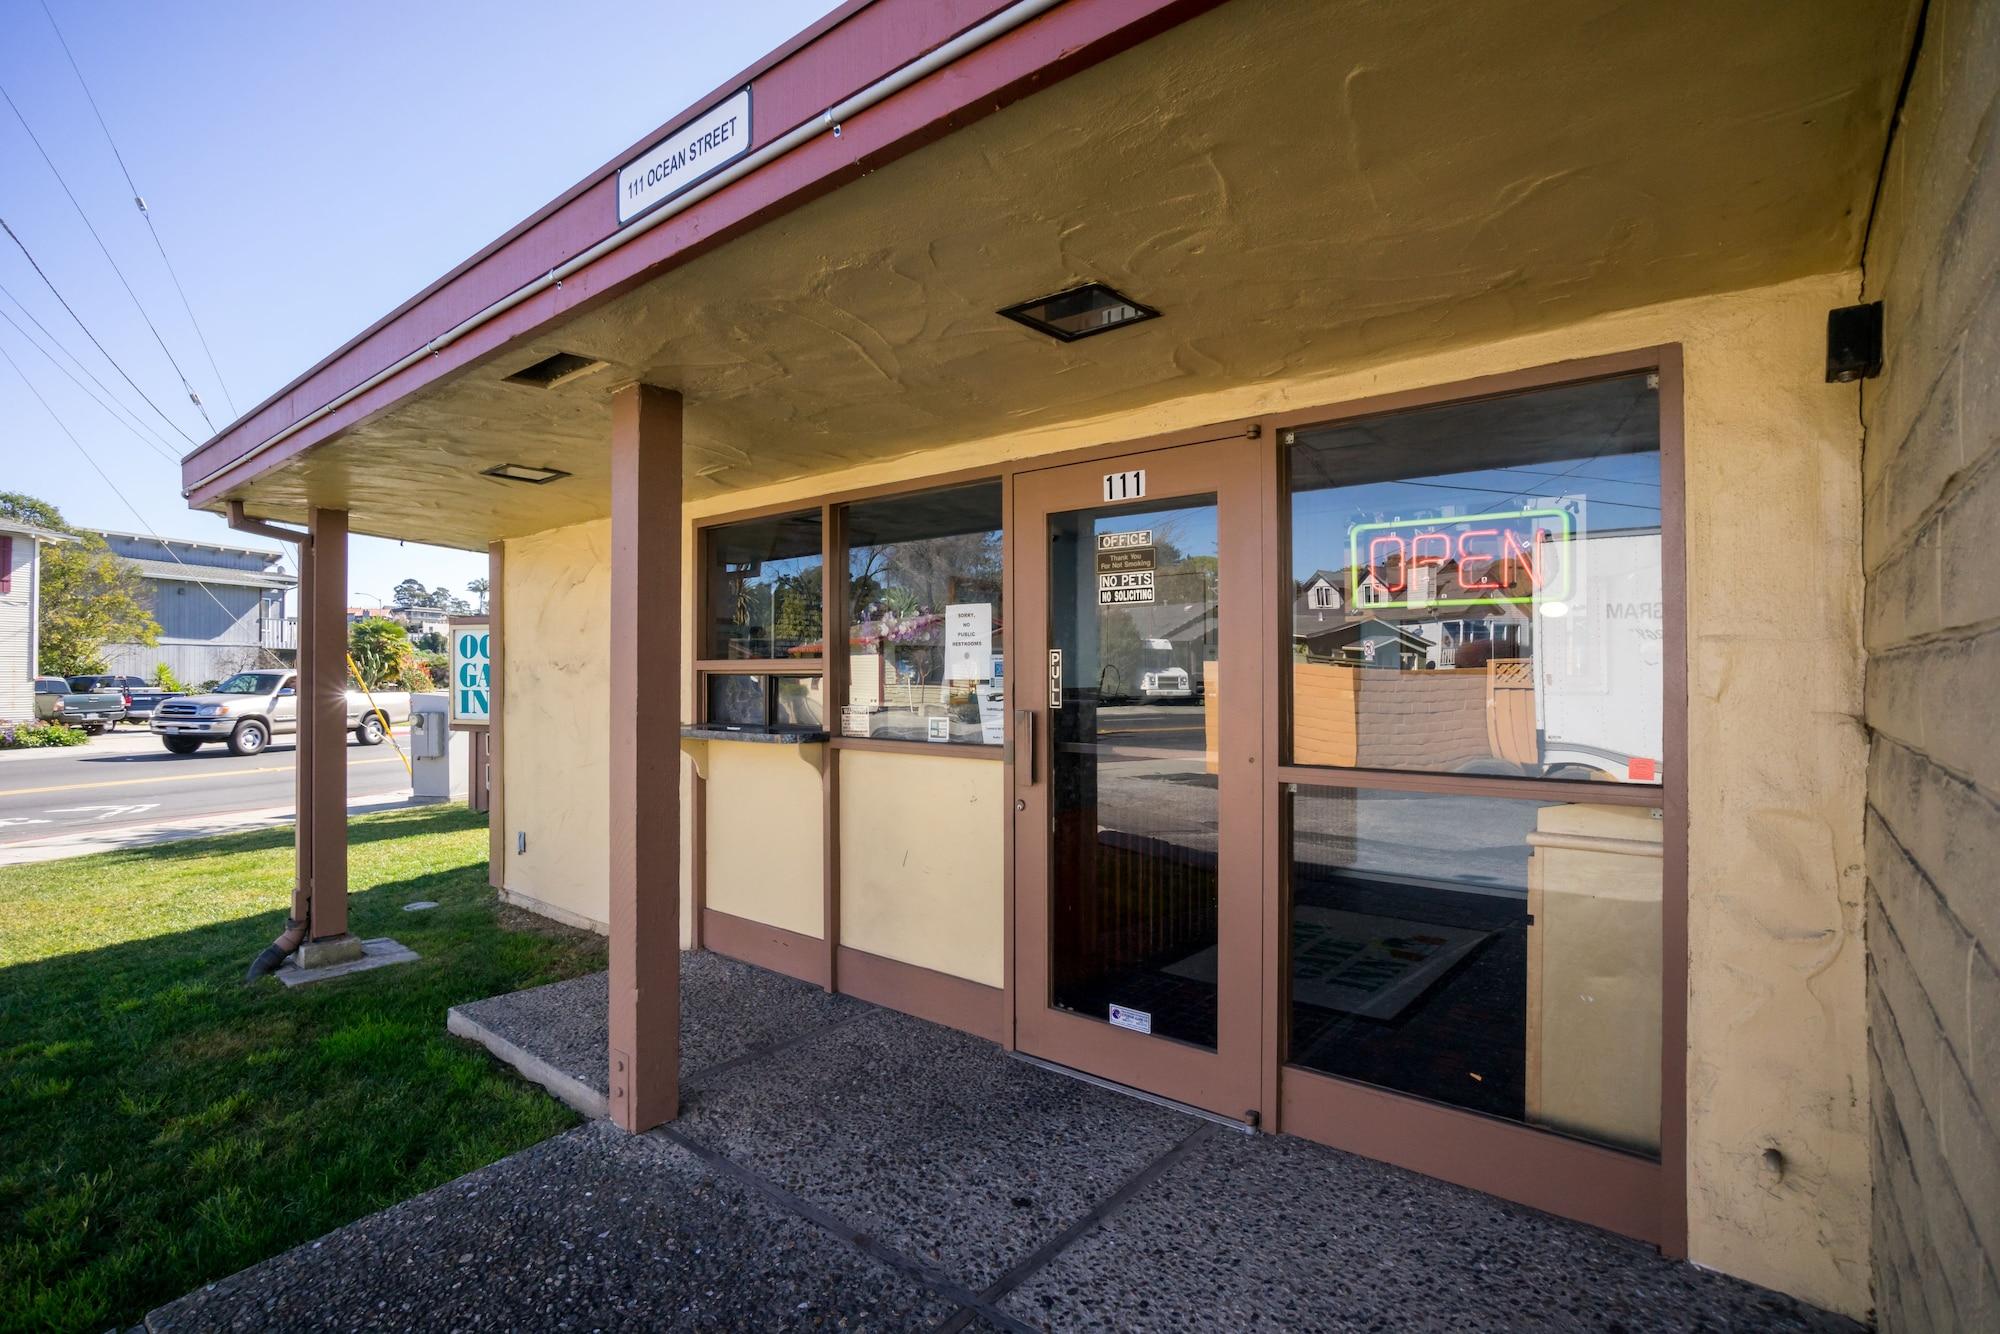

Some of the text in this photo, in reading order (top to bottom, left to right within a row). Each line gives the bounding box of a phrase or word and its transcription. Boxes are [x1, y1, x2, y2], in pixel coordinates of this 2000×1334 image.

[628, 116, 737, 199] 111 OCEAN STREET
[1106, 471, 1140, 500] 111
[1102, 532, 1147, 548] OFFICE
[1100, 559, 1151, 570] For Not Smoking
[1110, 554, 1128, 562] Thank
[1369, 527, 1546, 592] OPEN
[1102, 573, 1151, 587] NO PETS
[1102, 588, 1152, 602] NO SOLICITING
[1051, 653, 1060, 705] PULL
